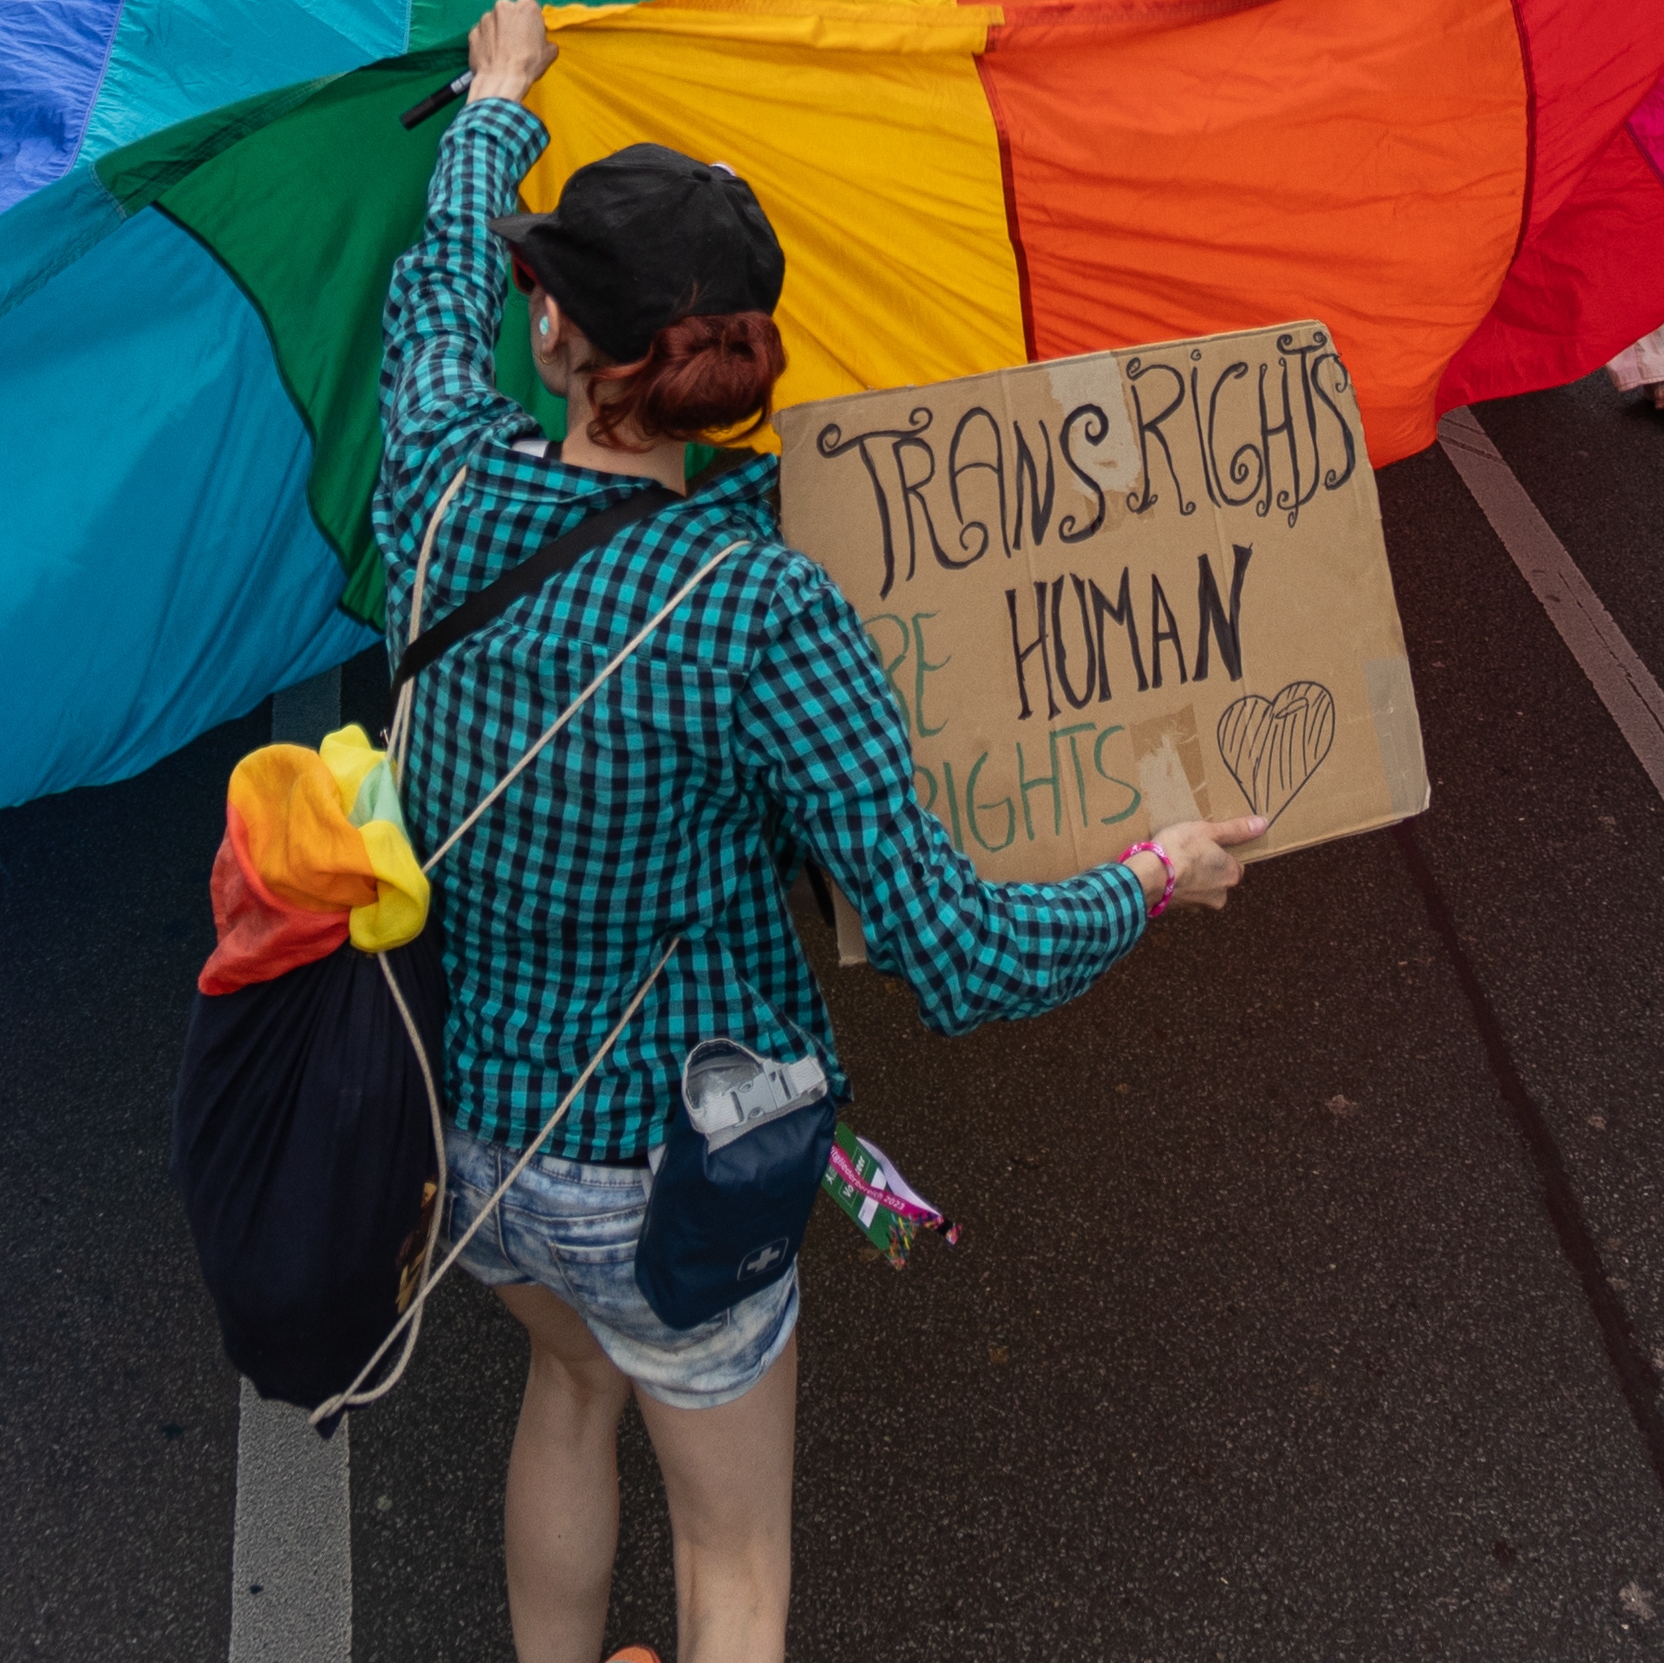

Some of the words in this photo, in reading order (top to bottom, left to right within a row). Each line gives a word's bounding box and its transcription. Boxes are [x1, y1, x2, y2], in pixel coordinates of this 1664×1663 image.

[816, 402, 1111, 598] TRANS
[1123, 331, 1359, 527] RIGHTS
[1005, 543, 1254, 721] HUMAN
[831, 1146, 884, 1200] itgliederbereich
[883, 1194, 906, 1211] 2023
